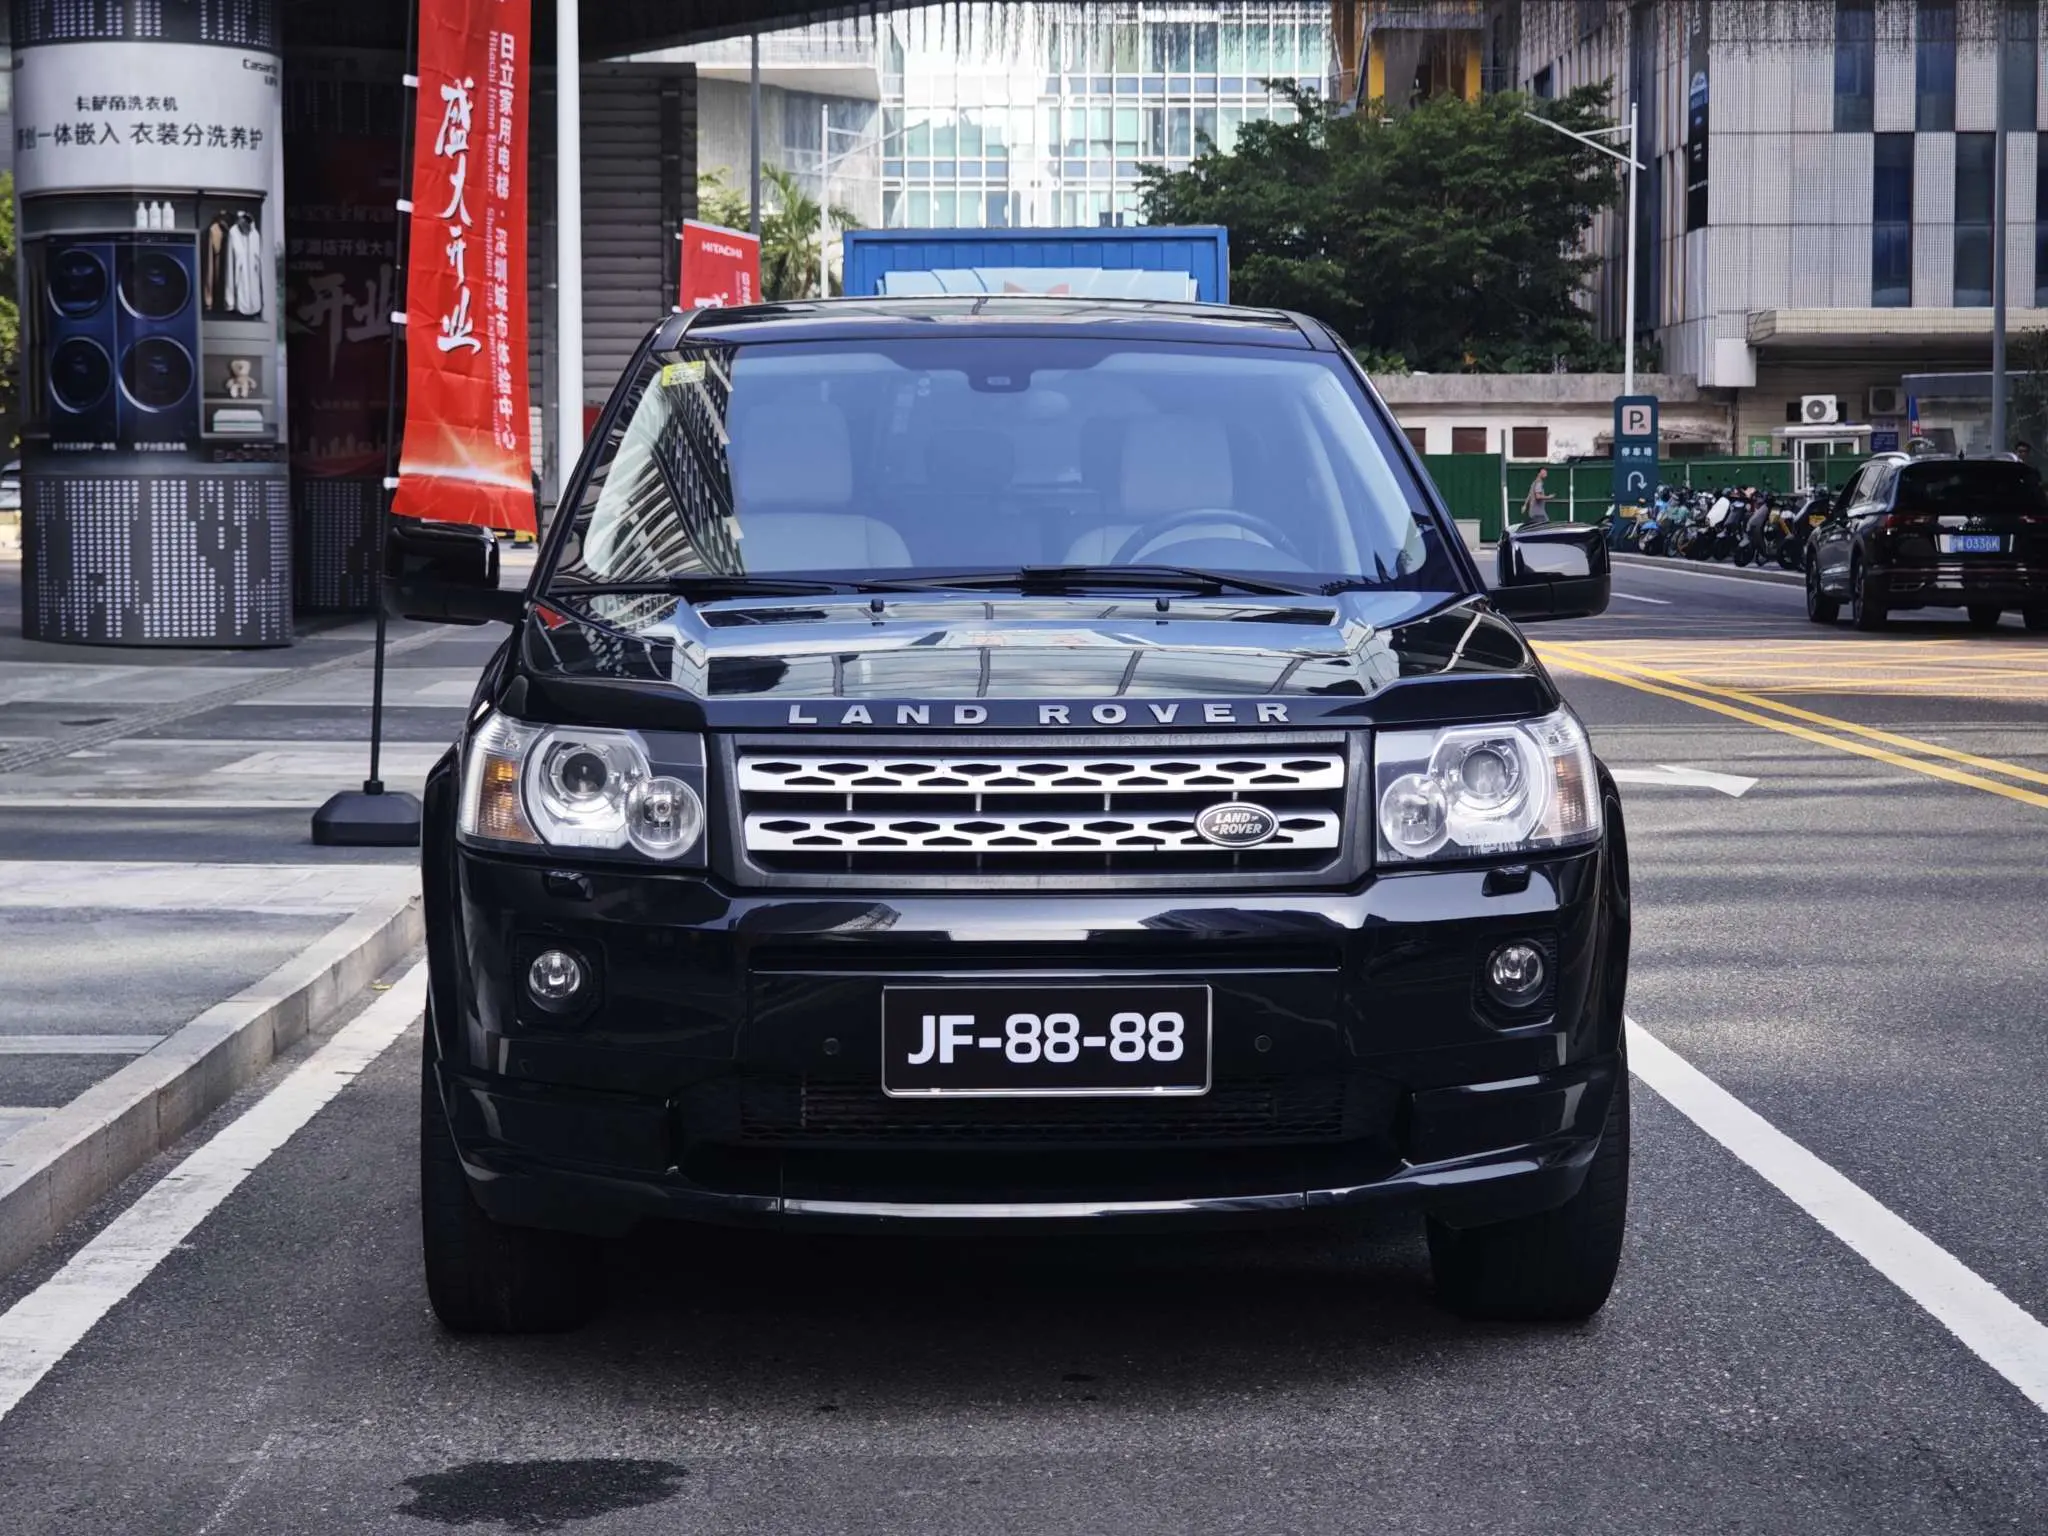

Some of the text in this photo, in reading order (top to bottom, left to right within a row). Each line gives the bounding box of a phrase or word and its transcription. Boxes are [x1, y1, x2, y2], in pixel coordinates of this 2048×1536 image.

[701, 240, 744, 260] HITACHI
[787, 702, 1291, 726] LAND ROVER
[1215, 812, 1251, 824] LAND
[1218, 823, 1263, 835] ROVER
[907, 1011, 1185, 1065] JF-88-88
